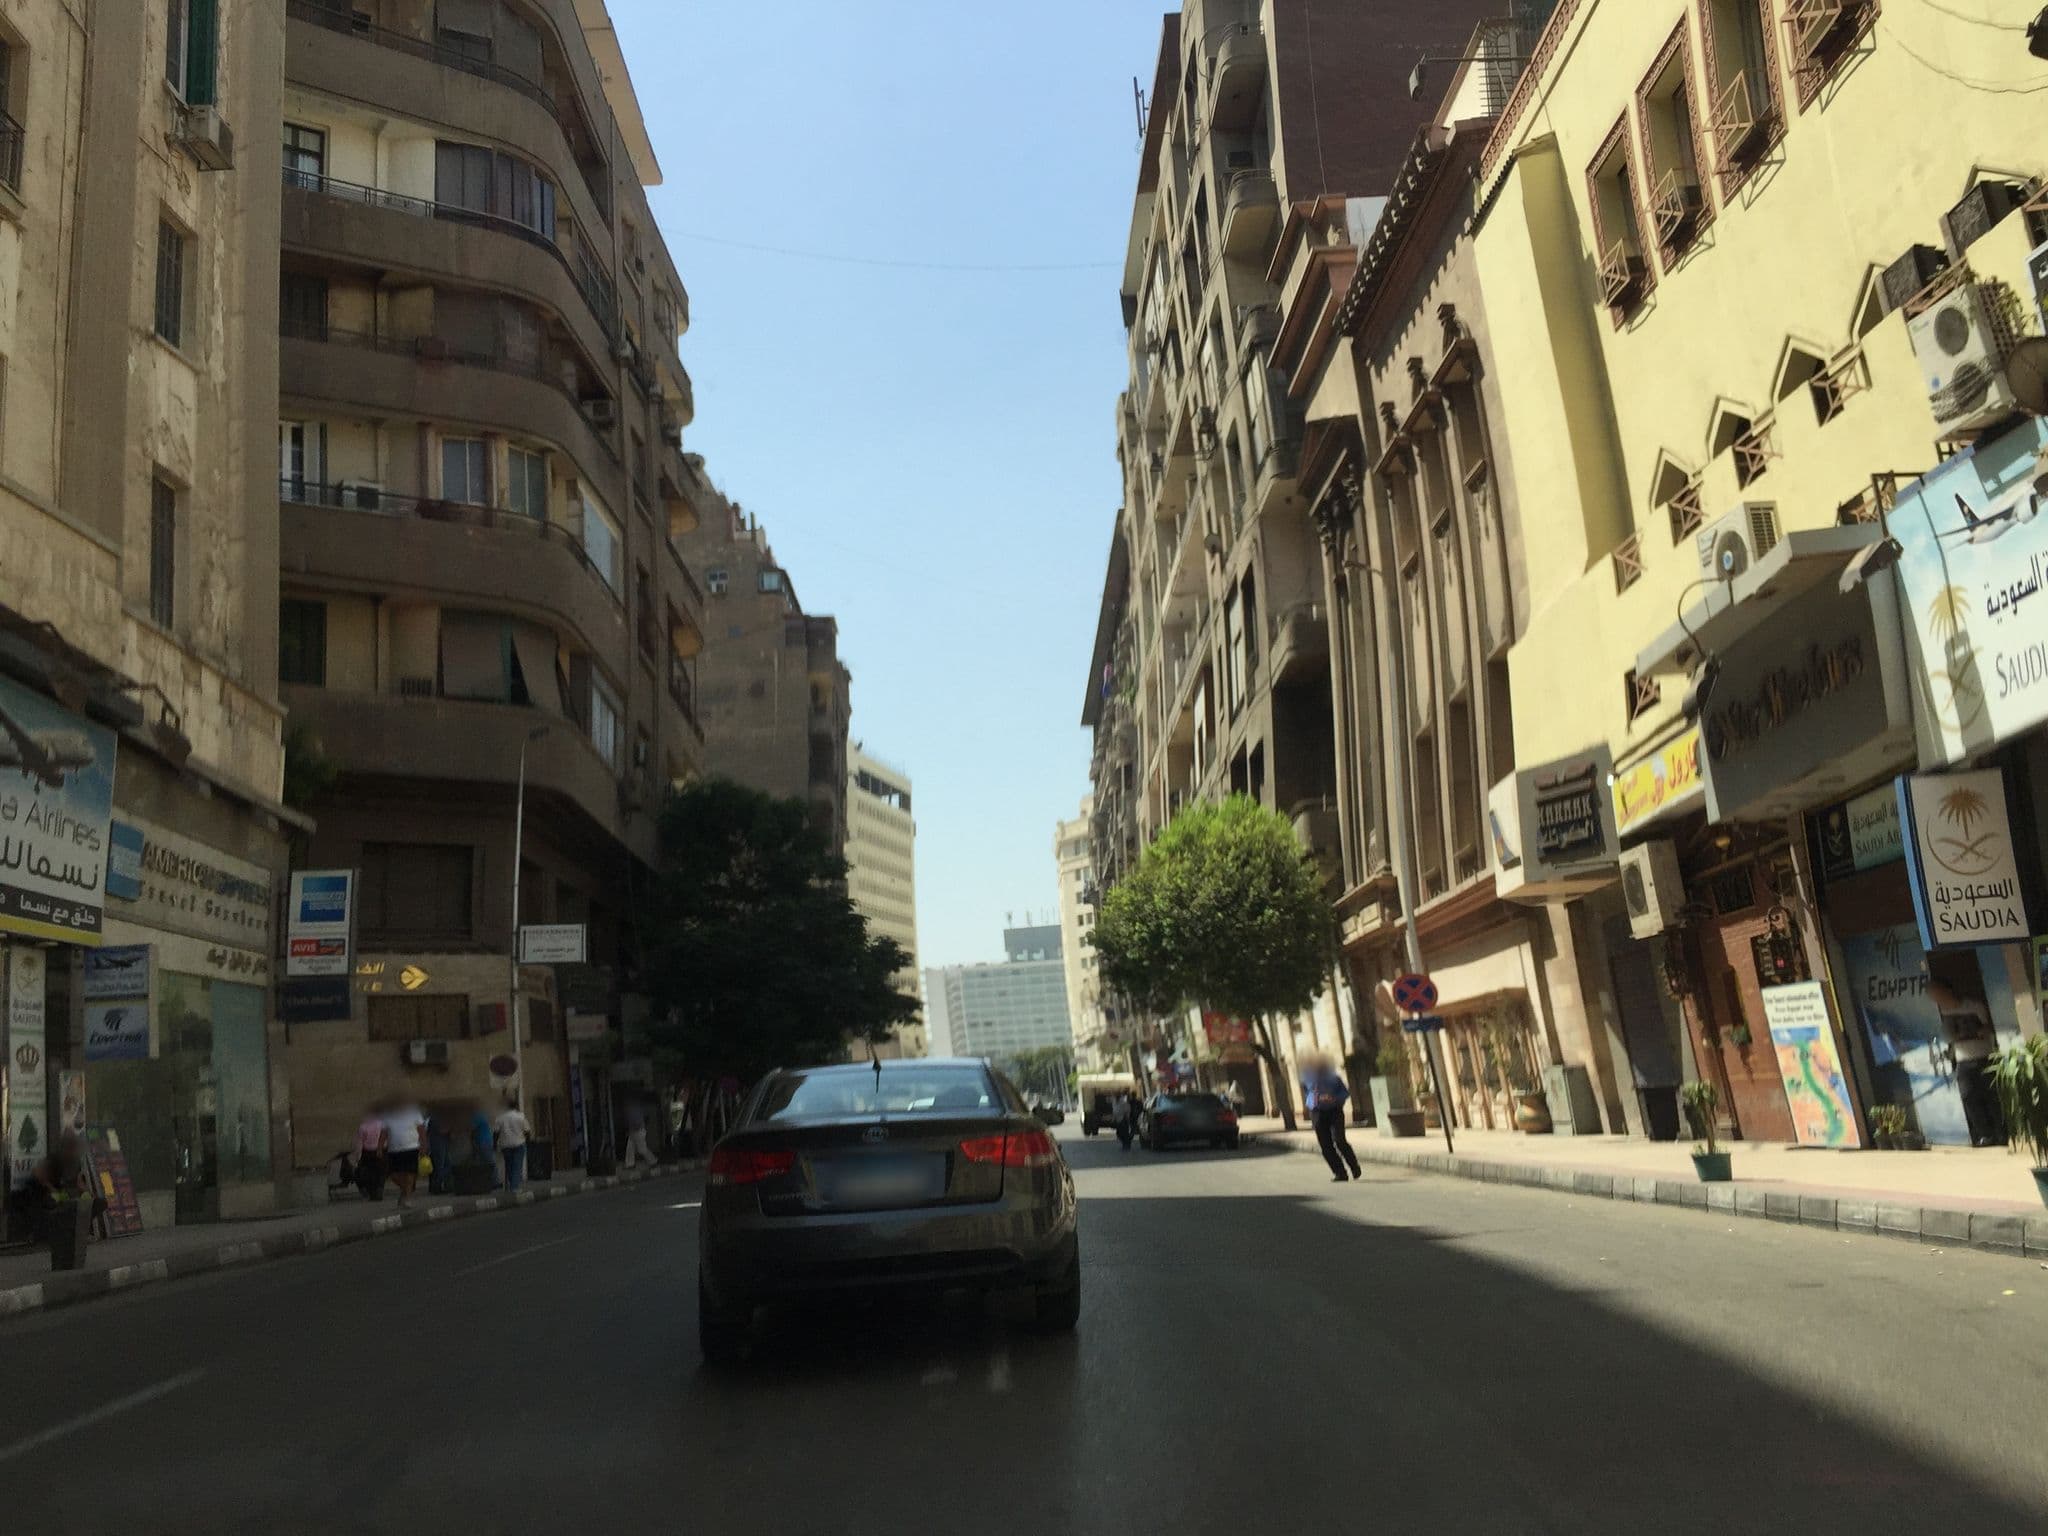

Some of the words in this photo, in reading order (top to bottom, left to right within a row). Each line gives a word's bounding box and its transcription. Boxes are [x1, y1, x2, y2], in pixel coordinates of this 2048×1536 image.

[1984, 553, 2044, 624] السعودية
[25, 800, 101, 851] Airlines
[1935, 878, 2014, 910] السعودية
[1939, 907, 2020, 932] SAUDIA
[292, 943, 317, 953] AVIS
[1867, 974, 1929, 1002] EGYPTA
